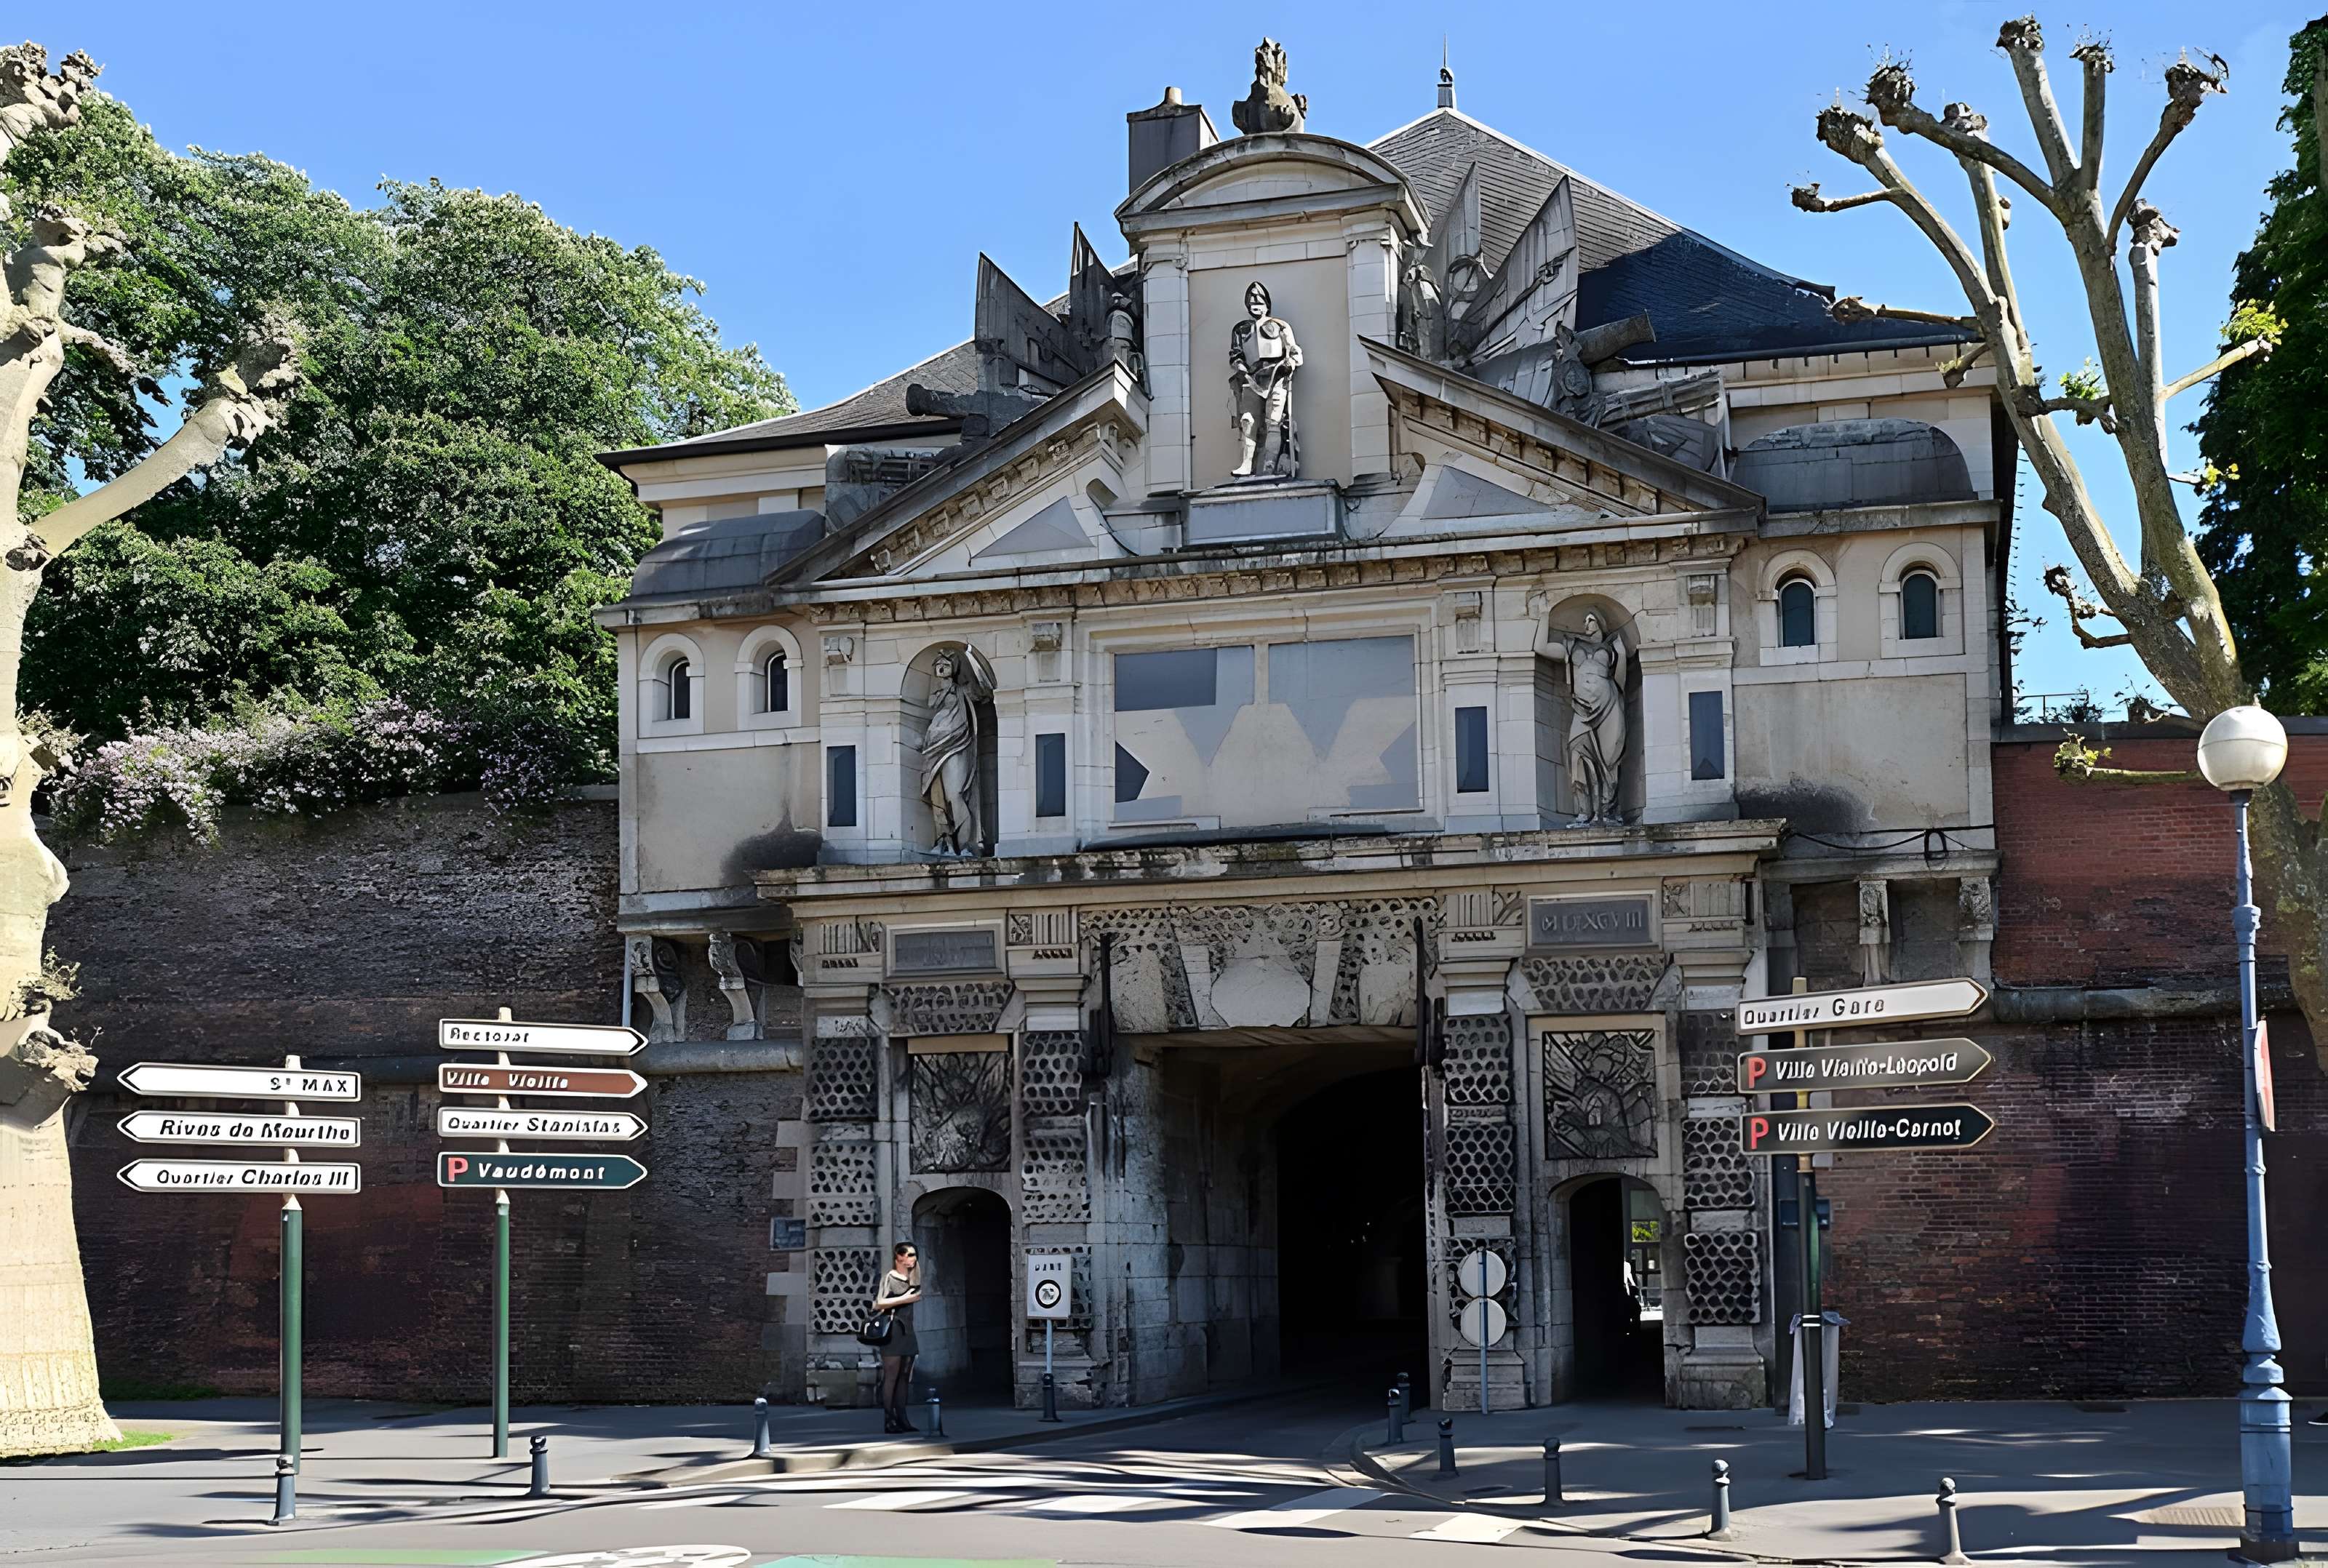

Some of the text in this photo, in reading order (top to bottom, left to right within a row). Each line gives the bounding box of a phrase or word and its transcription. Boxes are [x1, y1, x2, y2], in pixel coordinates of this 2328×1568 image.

[1745, 998, 1884, 1024] Quartier Gare
[1747, 1056, 1766, 1089] P
[302, 1079, 347, 1092] MAX
[159, 1119, 221, 1137] Rives
[229, 1122, 254, 1137] de
[448, 1116, 621, 1134] Quartier Stanislas
[1750, 1116, 1769, 1149] P
[156, 1169, 349, 1185] Quartier Charles III
[447, 1157, 469, 1182] P
